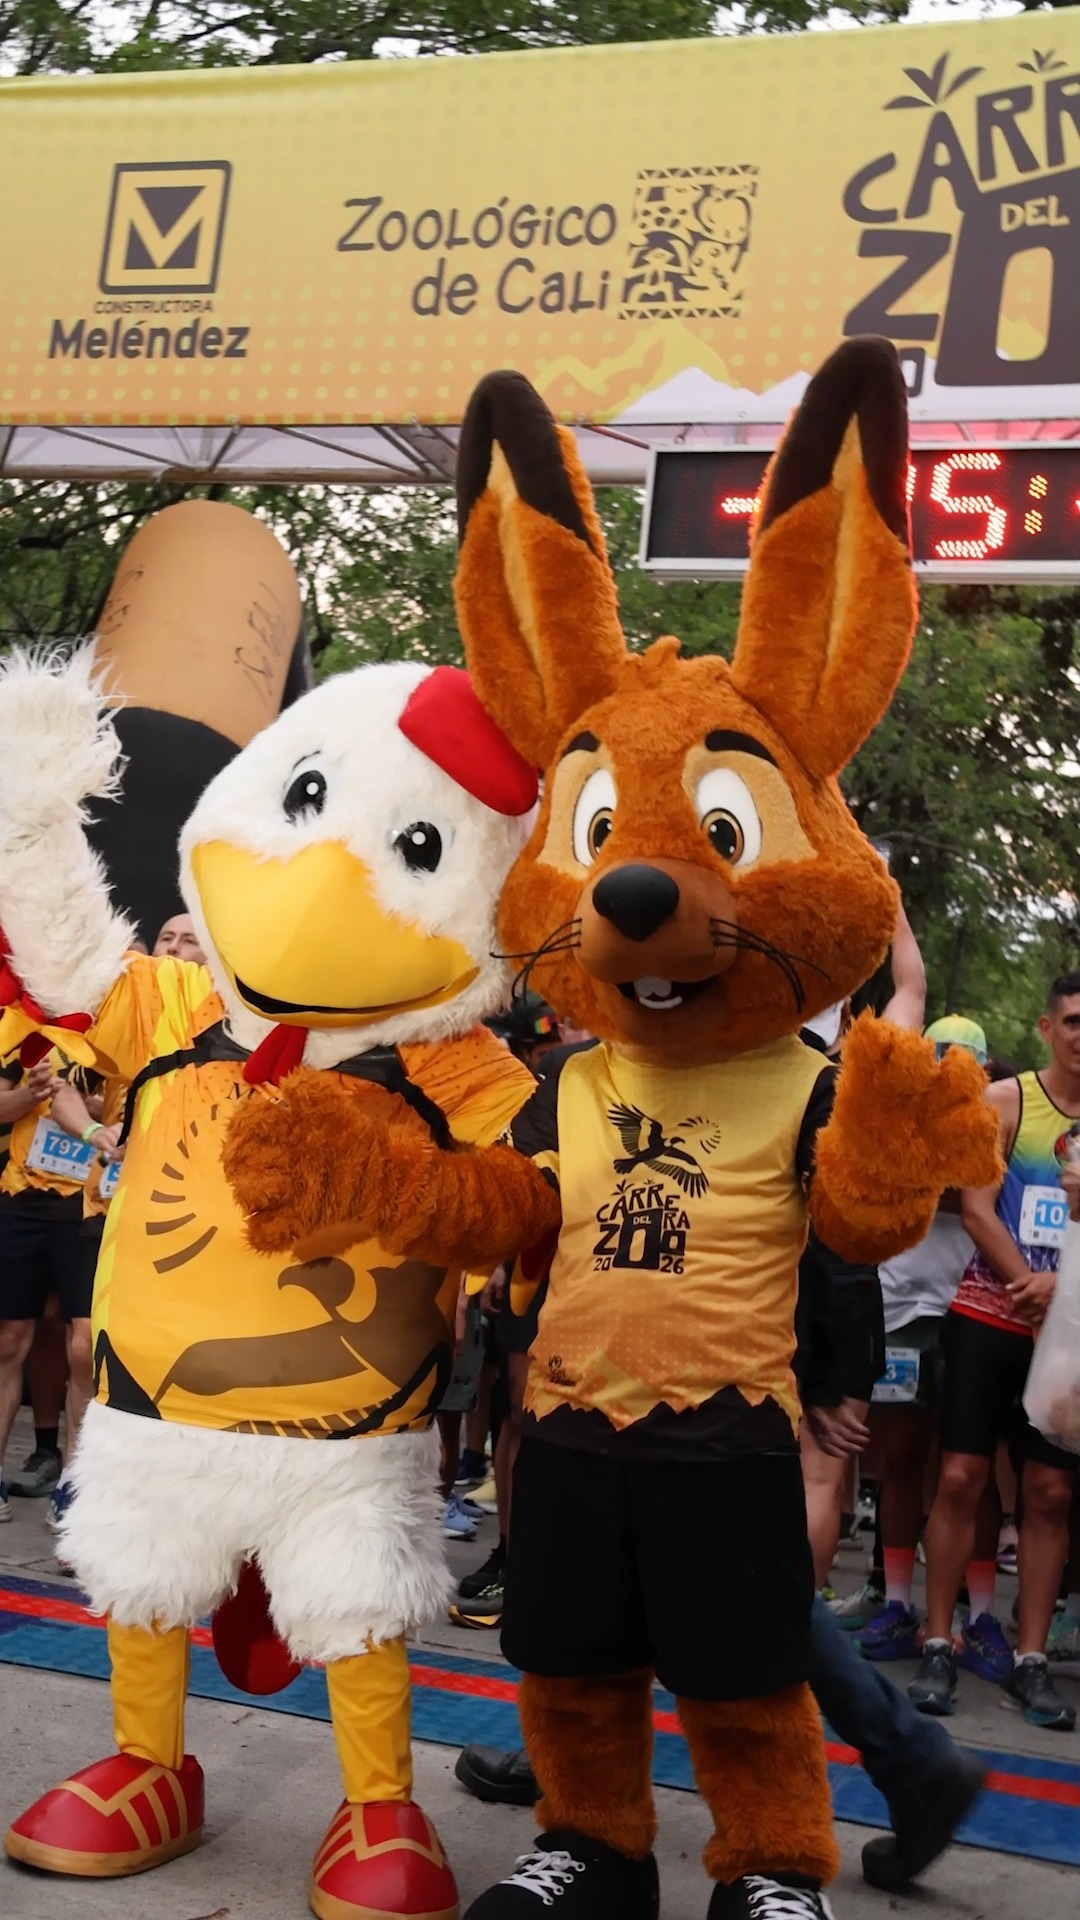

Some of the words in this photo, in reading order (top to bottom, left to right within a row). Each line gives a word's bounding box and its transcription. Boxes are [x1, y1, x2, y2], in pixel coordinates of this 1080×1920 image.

[1001, 195, 1070, 232] DEL
[411, 257, 478, 316] de
[94, 300, 214, 314] CONSTRUCTORA
[48, 317, 251, 359] Meléndez
[49, 1135, 84, 1158] 797
[633, 1215, 652, 1225] DEL
[1036, 1203, 1068, 1226] 10
